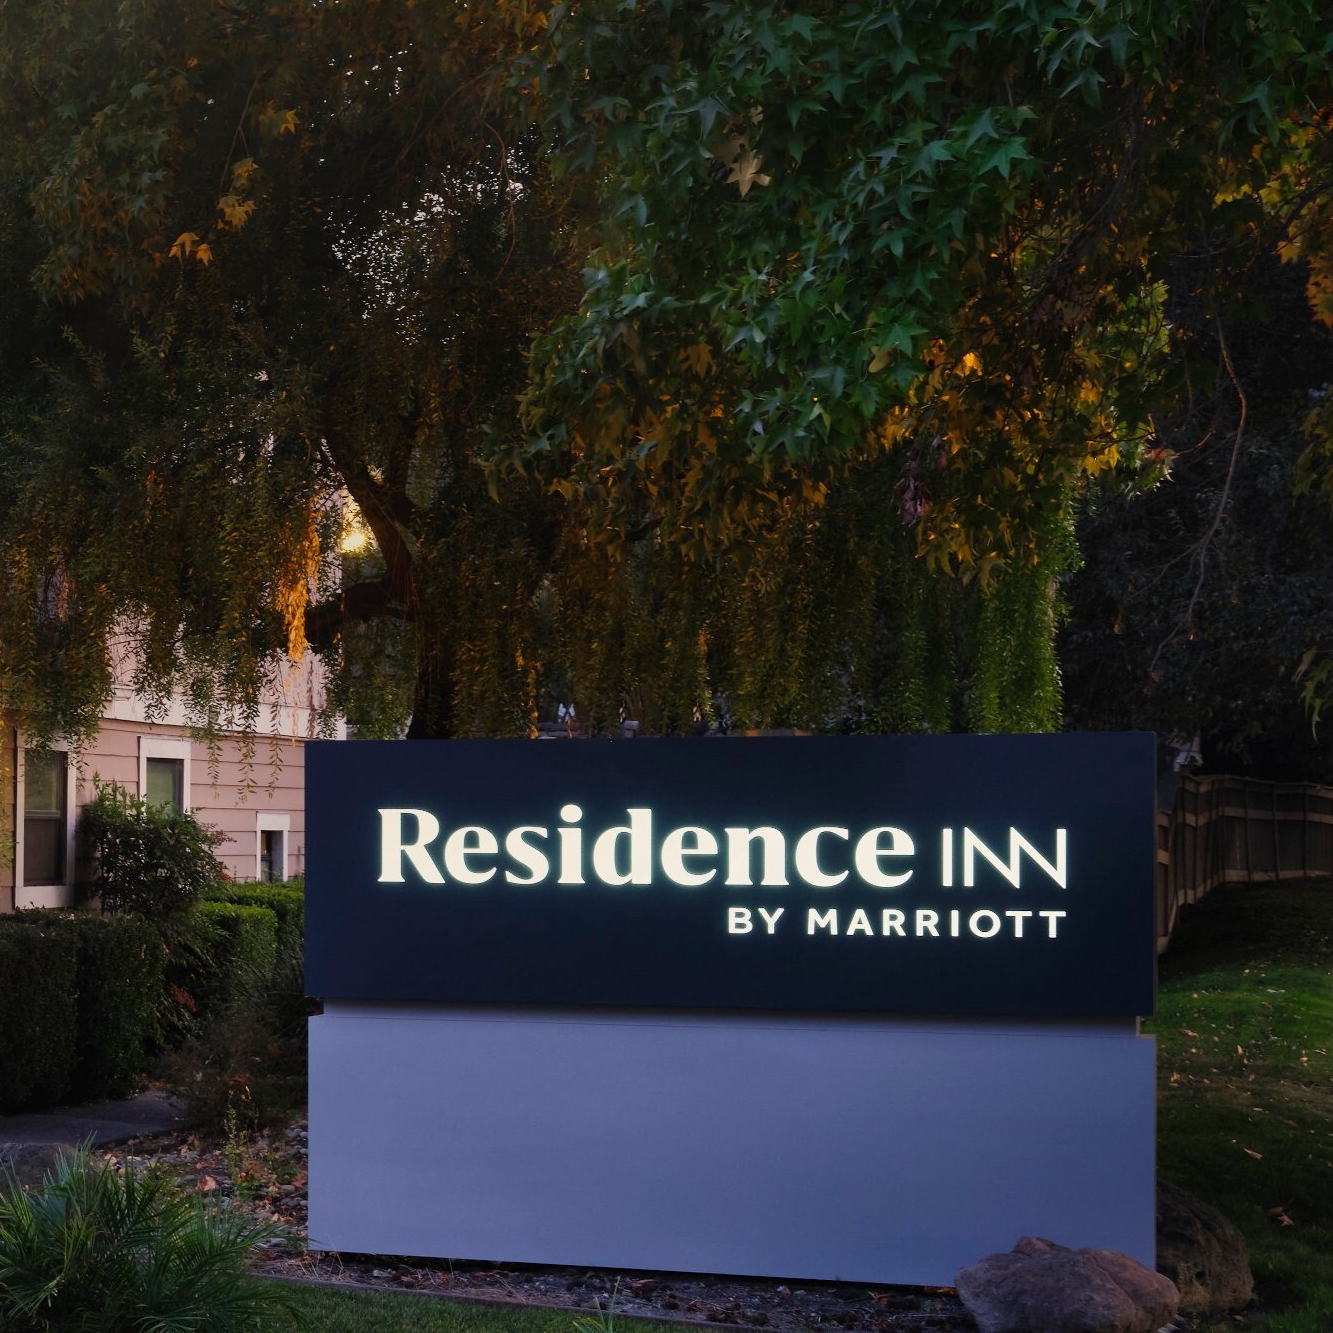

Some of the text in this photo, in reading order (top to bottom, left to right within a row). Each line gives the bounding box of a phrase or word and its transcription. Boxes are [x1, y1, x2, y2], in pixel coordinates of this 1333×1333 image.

[377, 804, 1067, 889] Residence INN
[727, 906, 1067, 939] BY MARRIOTT
